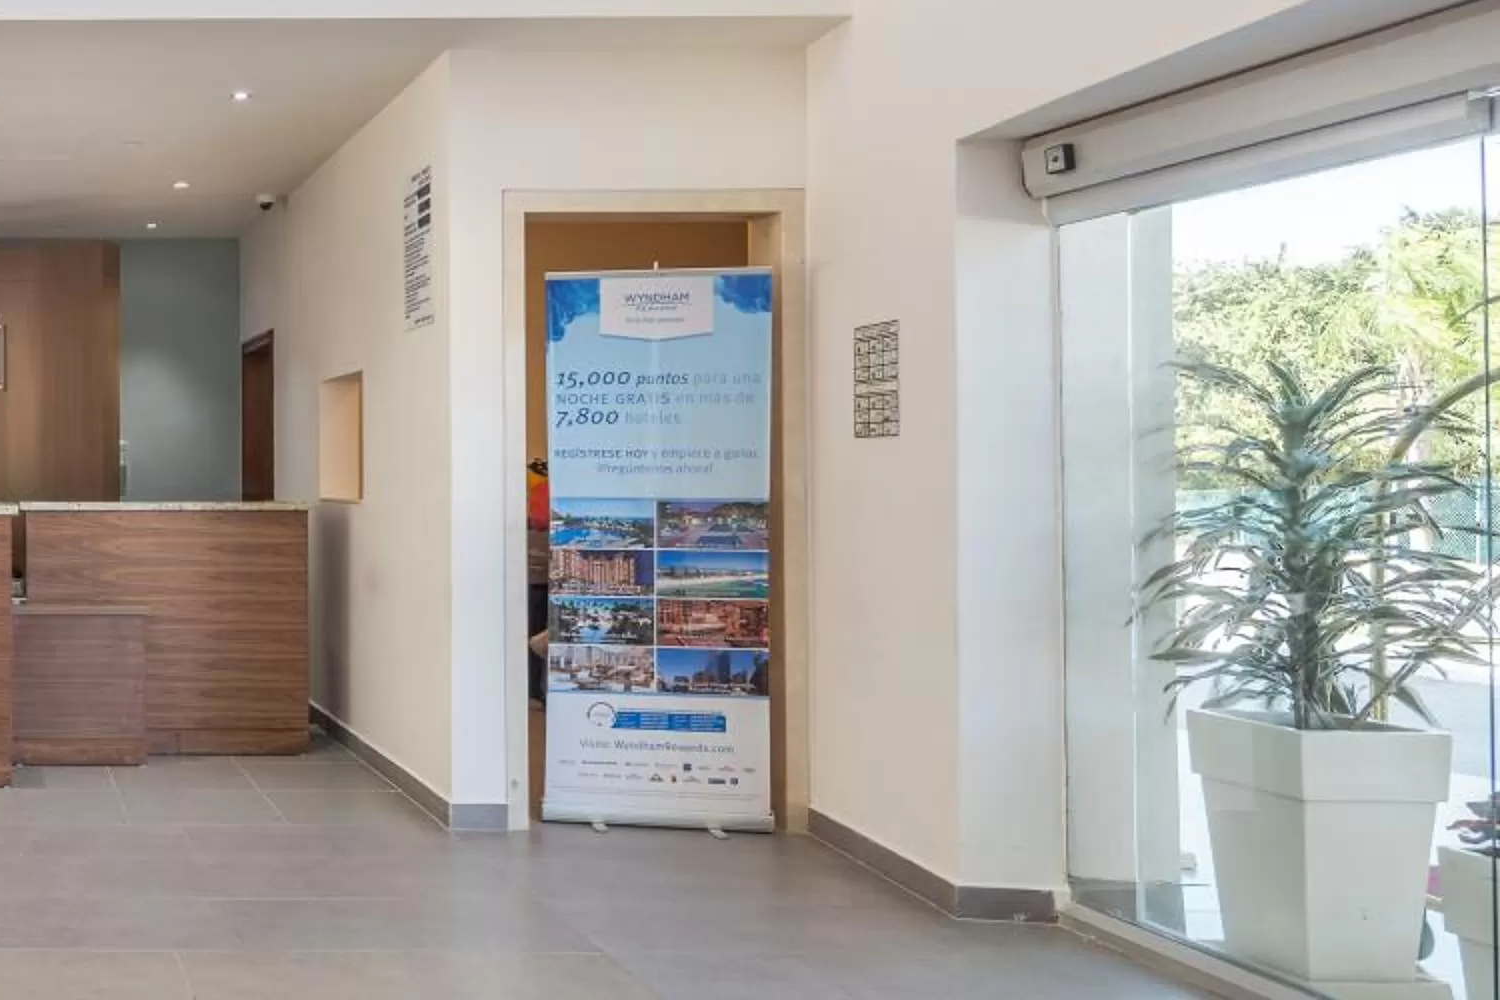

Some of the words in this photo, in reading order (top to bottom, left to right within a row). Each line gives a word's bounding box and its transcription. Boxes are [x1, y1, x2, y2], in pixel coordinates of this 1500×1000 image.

[556, 371, 631, 389] 15,000
[635, 372, 689, 388] puntos
[556, 393, 609, 405] NOCHE
[615, 393, 671, 405] GRATIS
[554, 407, 620, 428] 7,800
